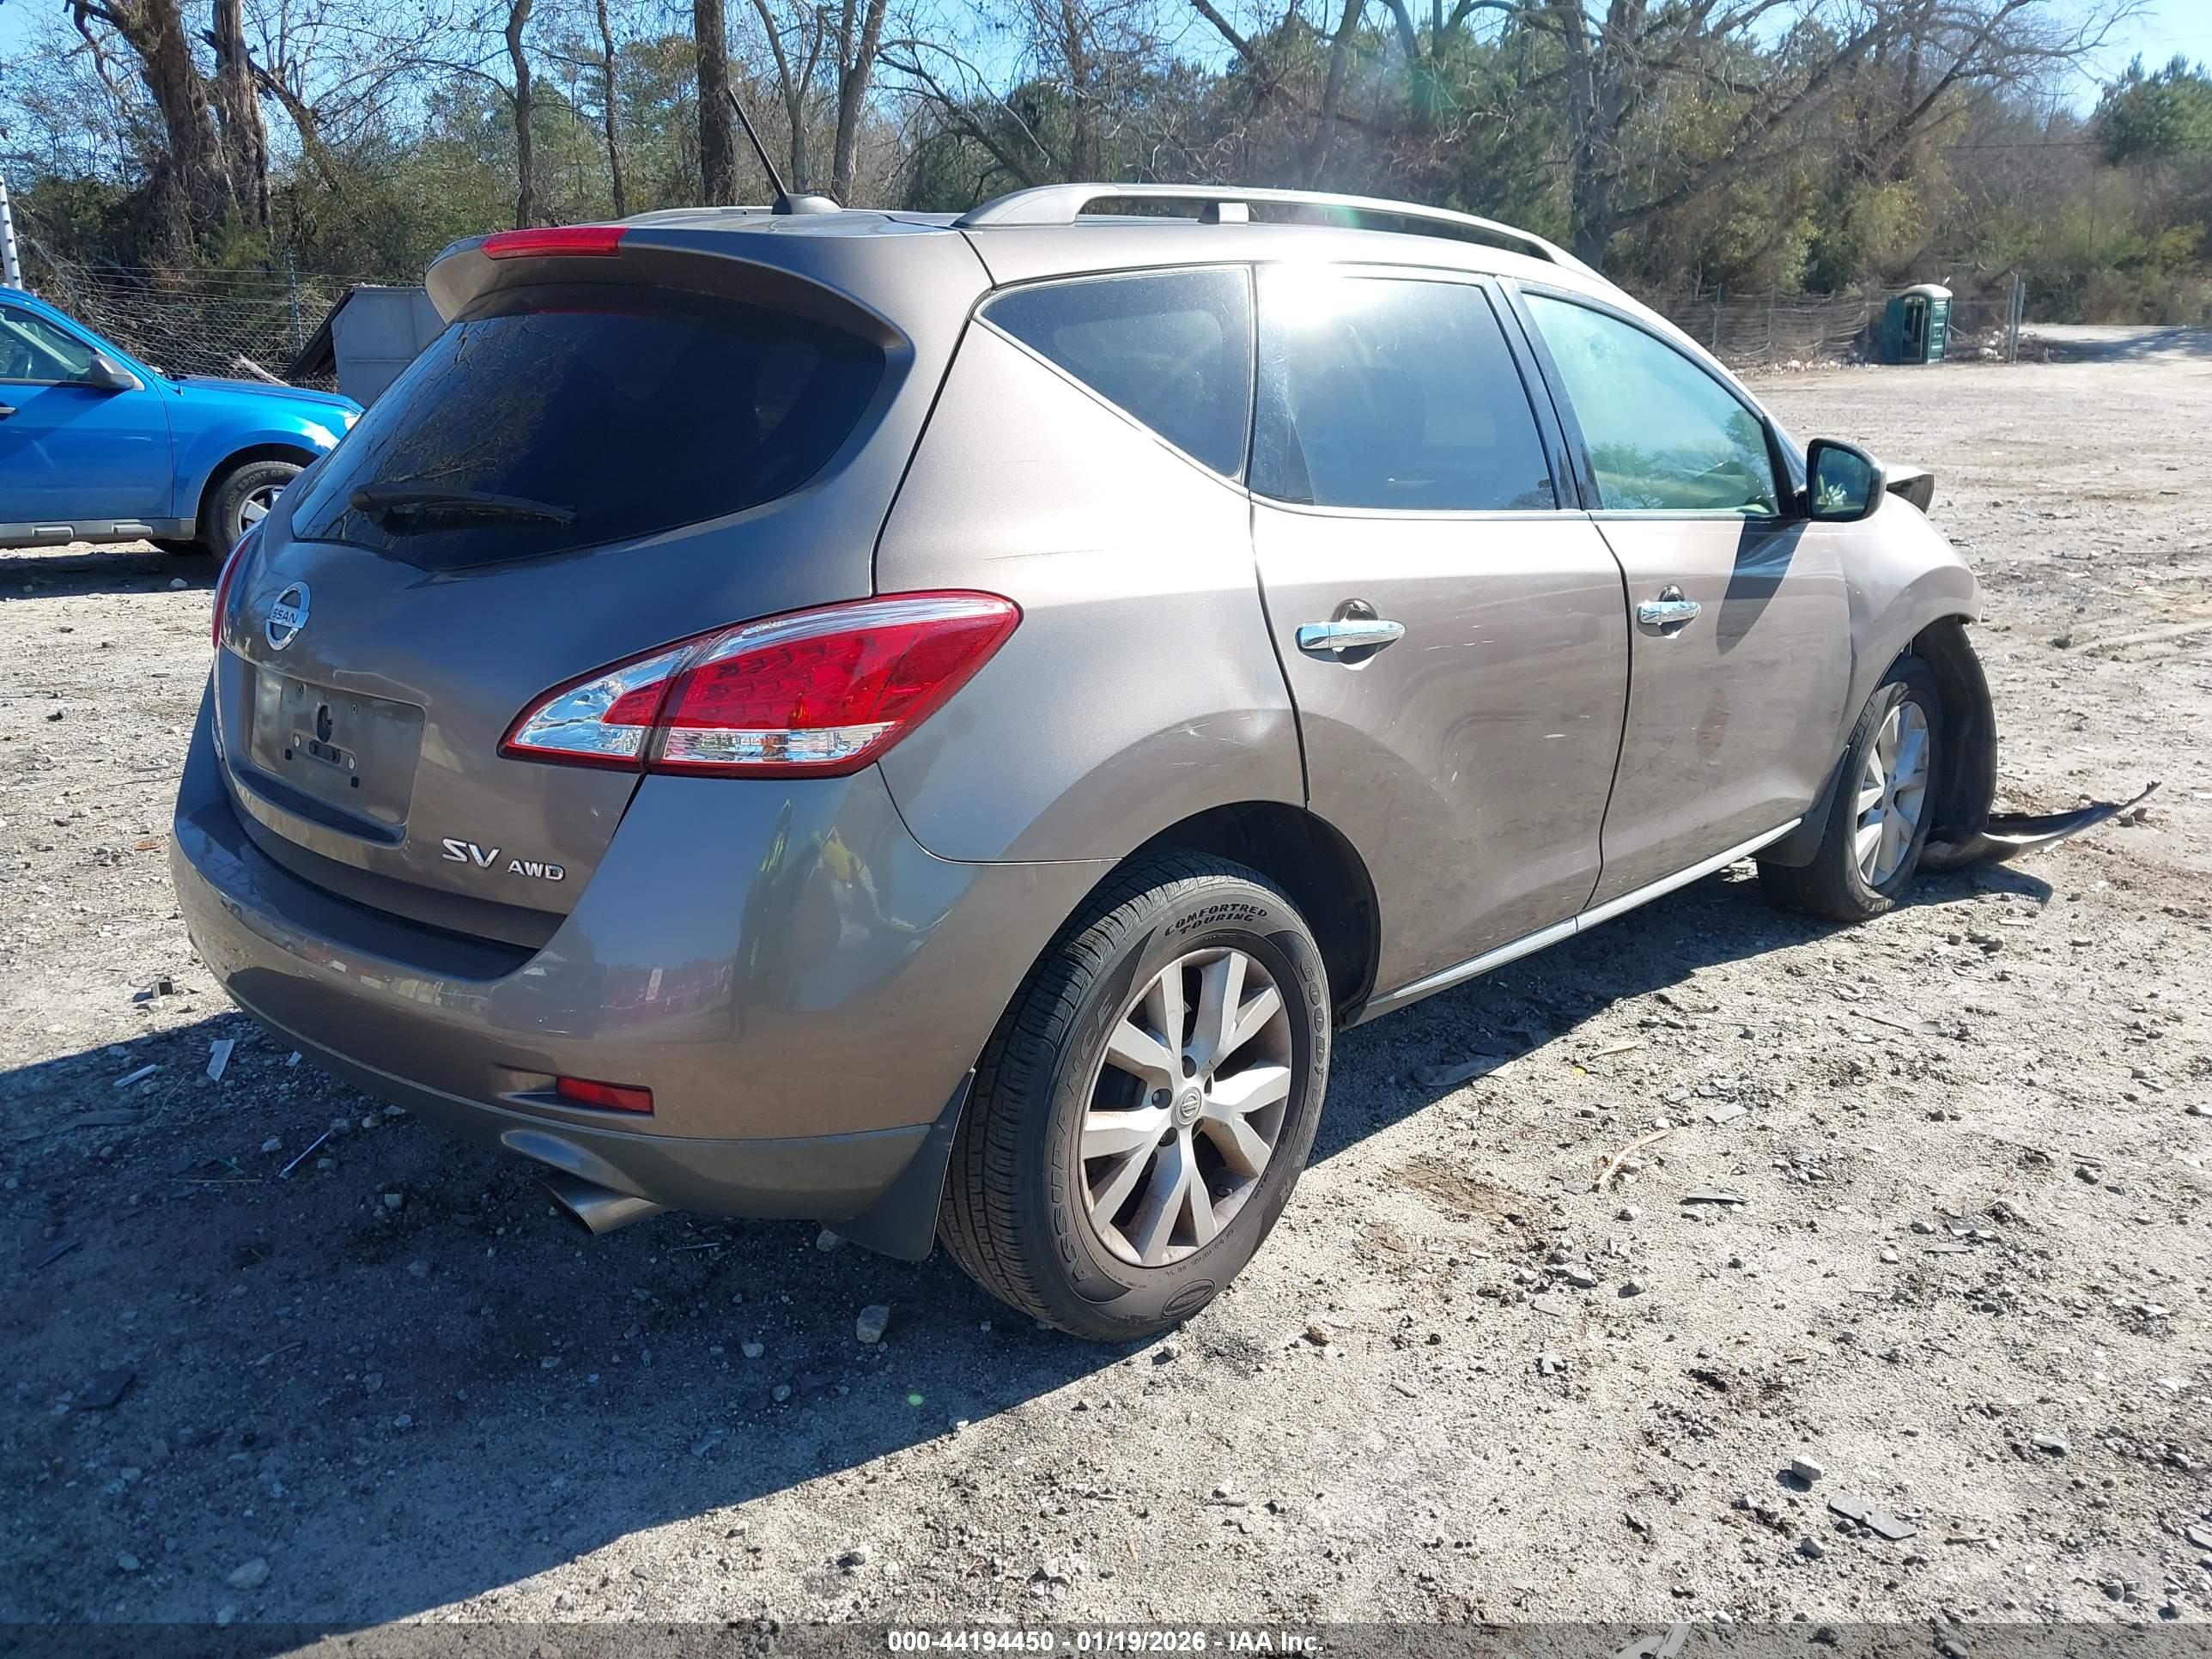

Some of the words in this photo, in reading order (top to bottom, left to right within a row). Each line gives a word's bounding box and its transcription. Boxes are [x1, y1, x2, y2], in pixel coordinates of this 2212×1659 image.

[238, 471, 267, 490] SPORT
[442, 837, 501, 870] SV
[507, 859, 565, 881] AWD
[1164, 902, 1268, 936] COMFORTRED
[1179, 912, 1255, 935] TOURING
[1051, 993, 1115, 1282] ASSURANCE
